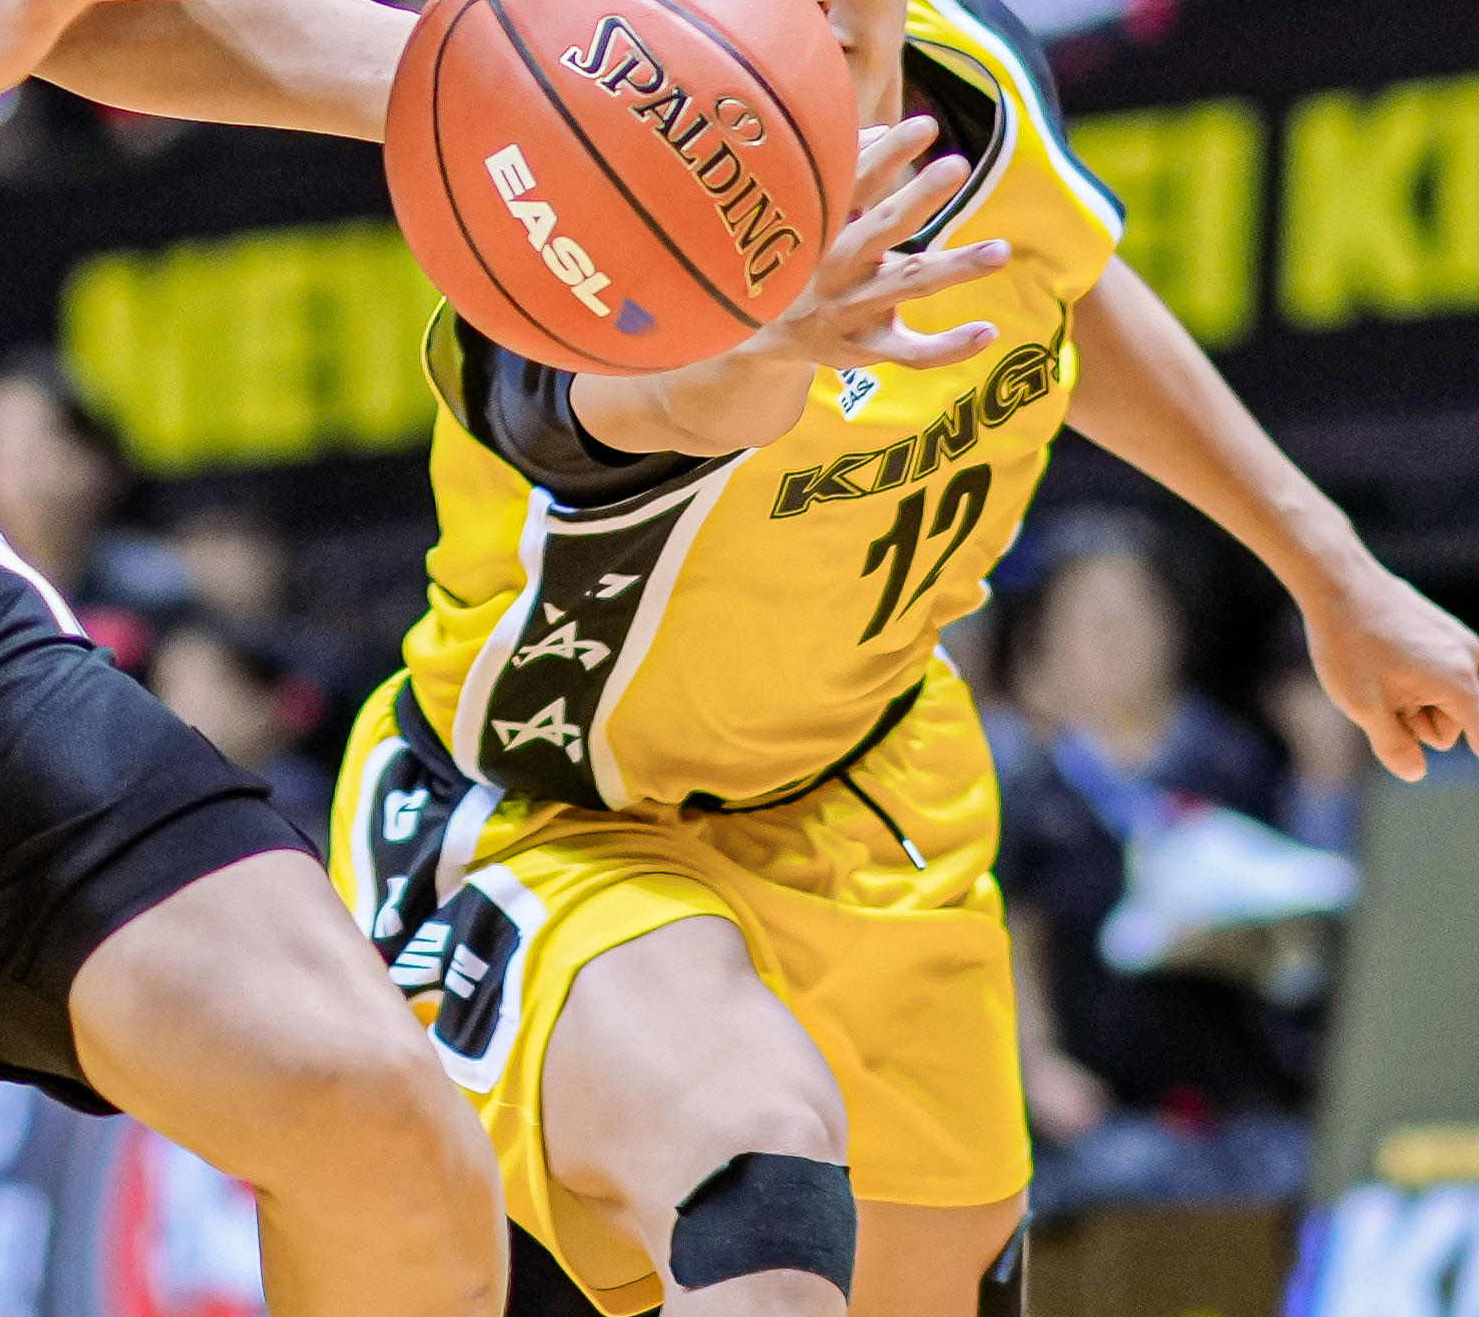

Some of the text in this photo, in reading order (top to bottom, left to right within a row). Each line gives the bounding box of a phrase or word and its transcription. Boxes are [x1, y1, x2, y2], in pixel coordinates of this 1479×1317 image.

[483, 142, 613, 319] EASL
[558, 14, 804, 300] SPALDING
[768, 340, 1061, 521] KING
[856, 460, 993, 648] 12
